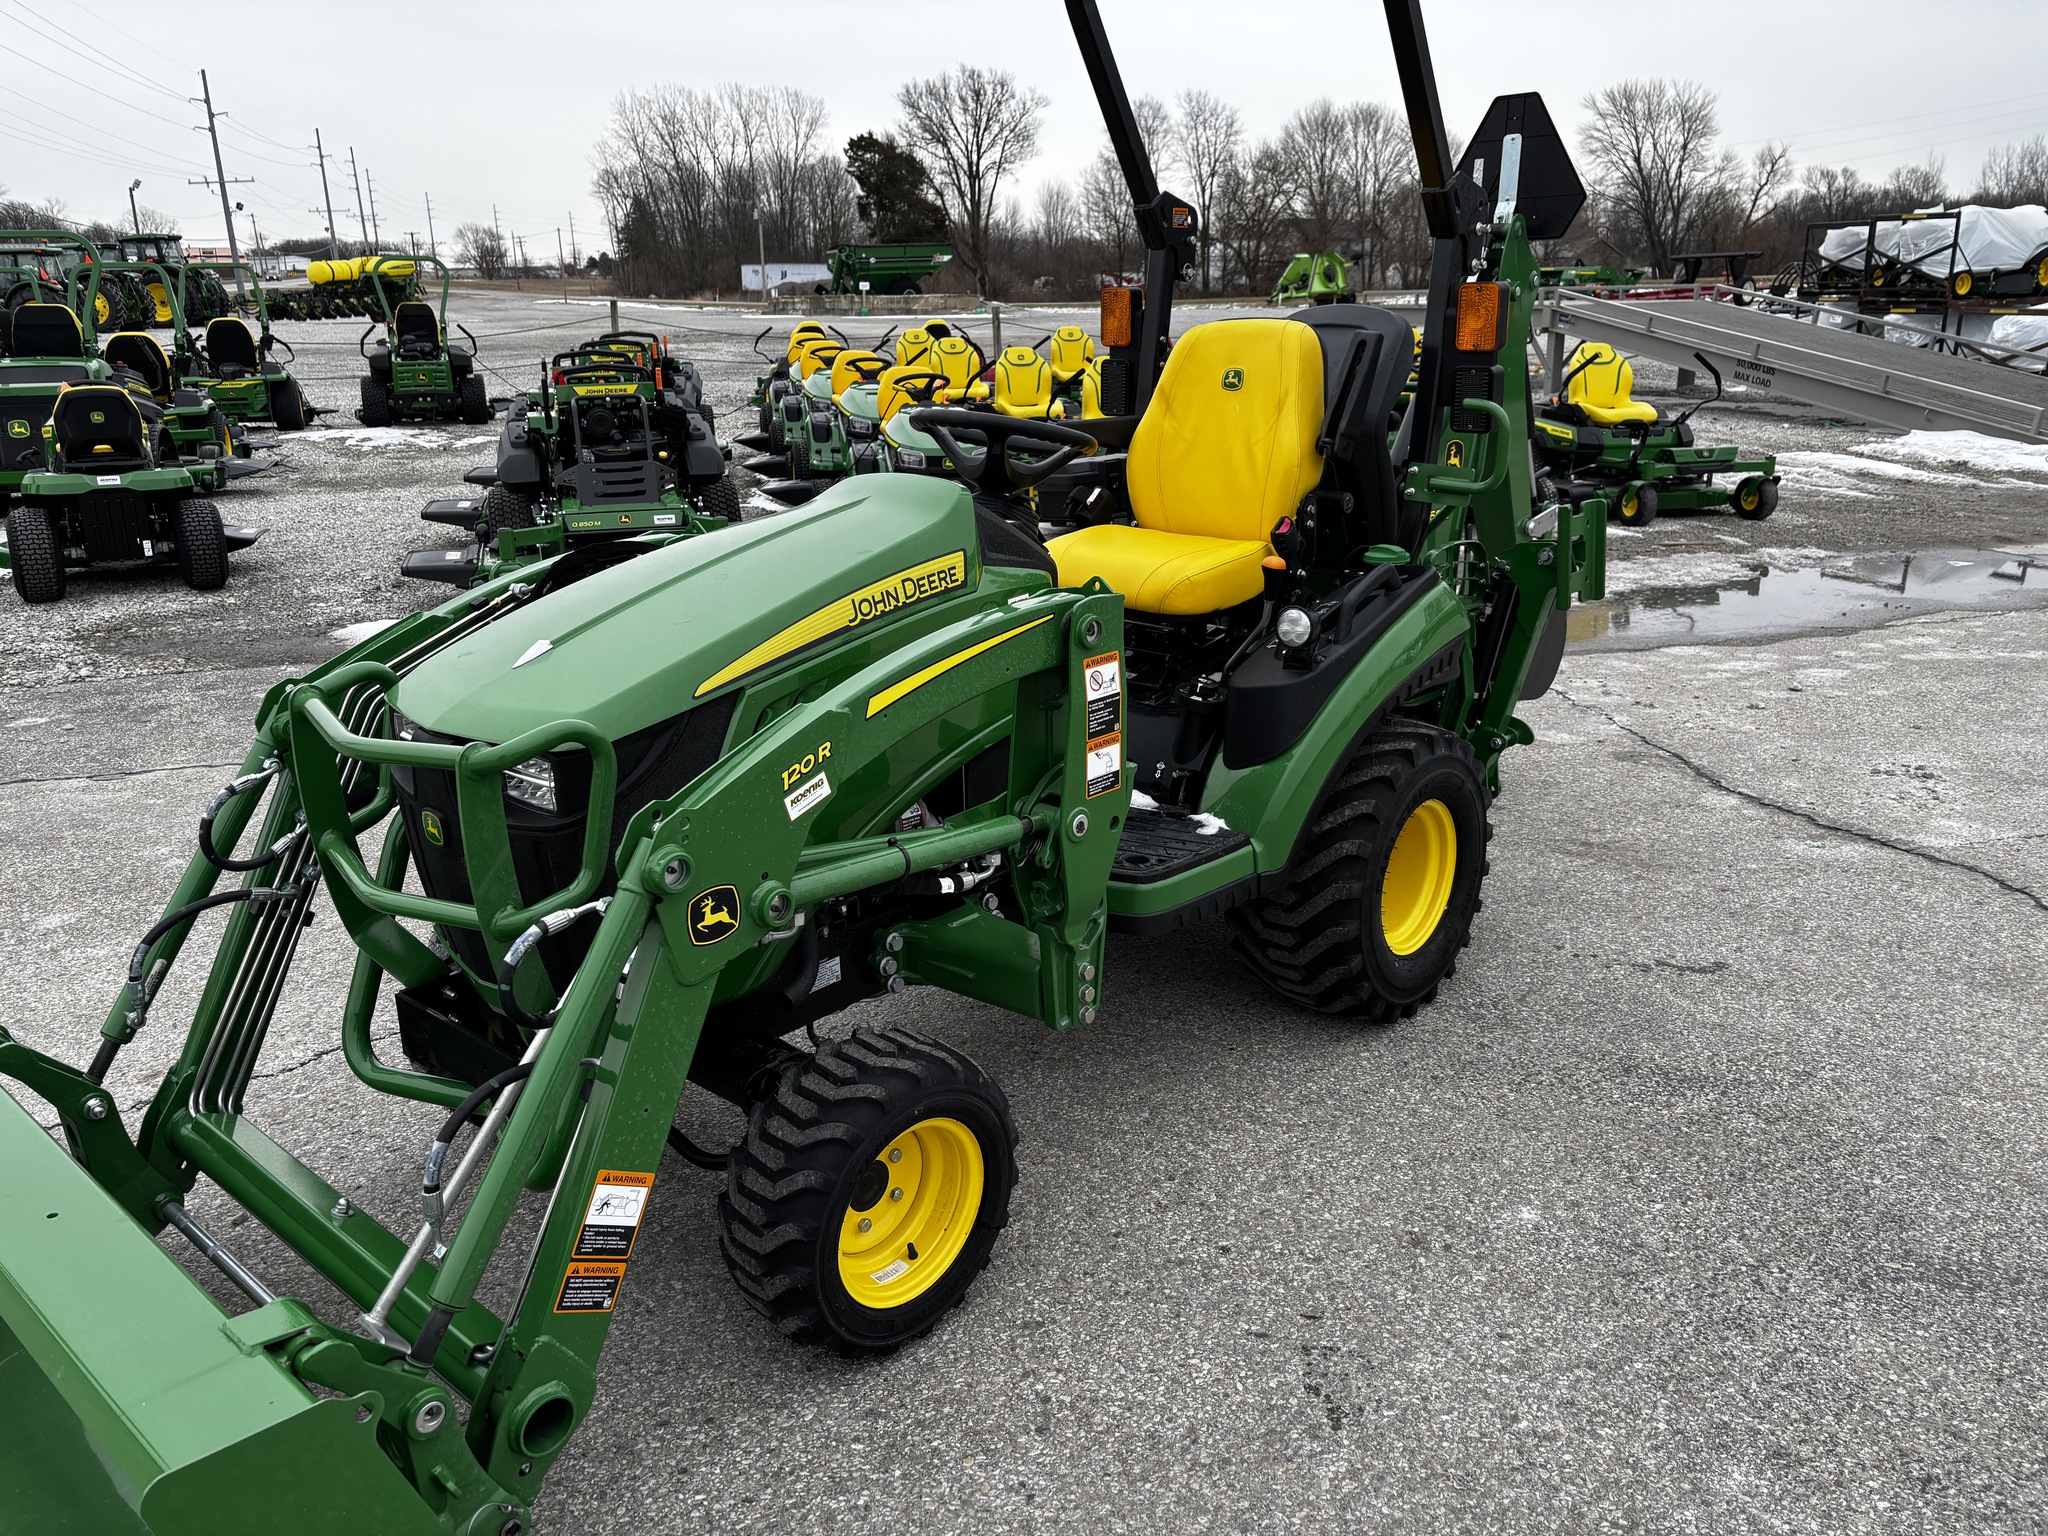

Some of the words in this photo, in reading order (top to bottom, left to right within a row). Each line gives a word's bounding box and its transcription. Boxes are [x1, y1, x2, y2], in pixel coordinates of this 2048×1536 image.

[1762, 364, 1776, 376] LBS
[1733, 370, 1750, 383] MAX
[1751, 375, 1771, 388] LOAD
[604, 387, 628, 395] DEERE
[848, 586, 901, 625] JOHN
[901, 566, 960, 602] DEERE
[1090, 653, 1118, 667] WARNING
[1093, 734, 1120, 749] WARNING
[781, 753, 816, 792] 120
[818, 741, 832, 764] R
[612, 1175, 648, 1185] WARNING
